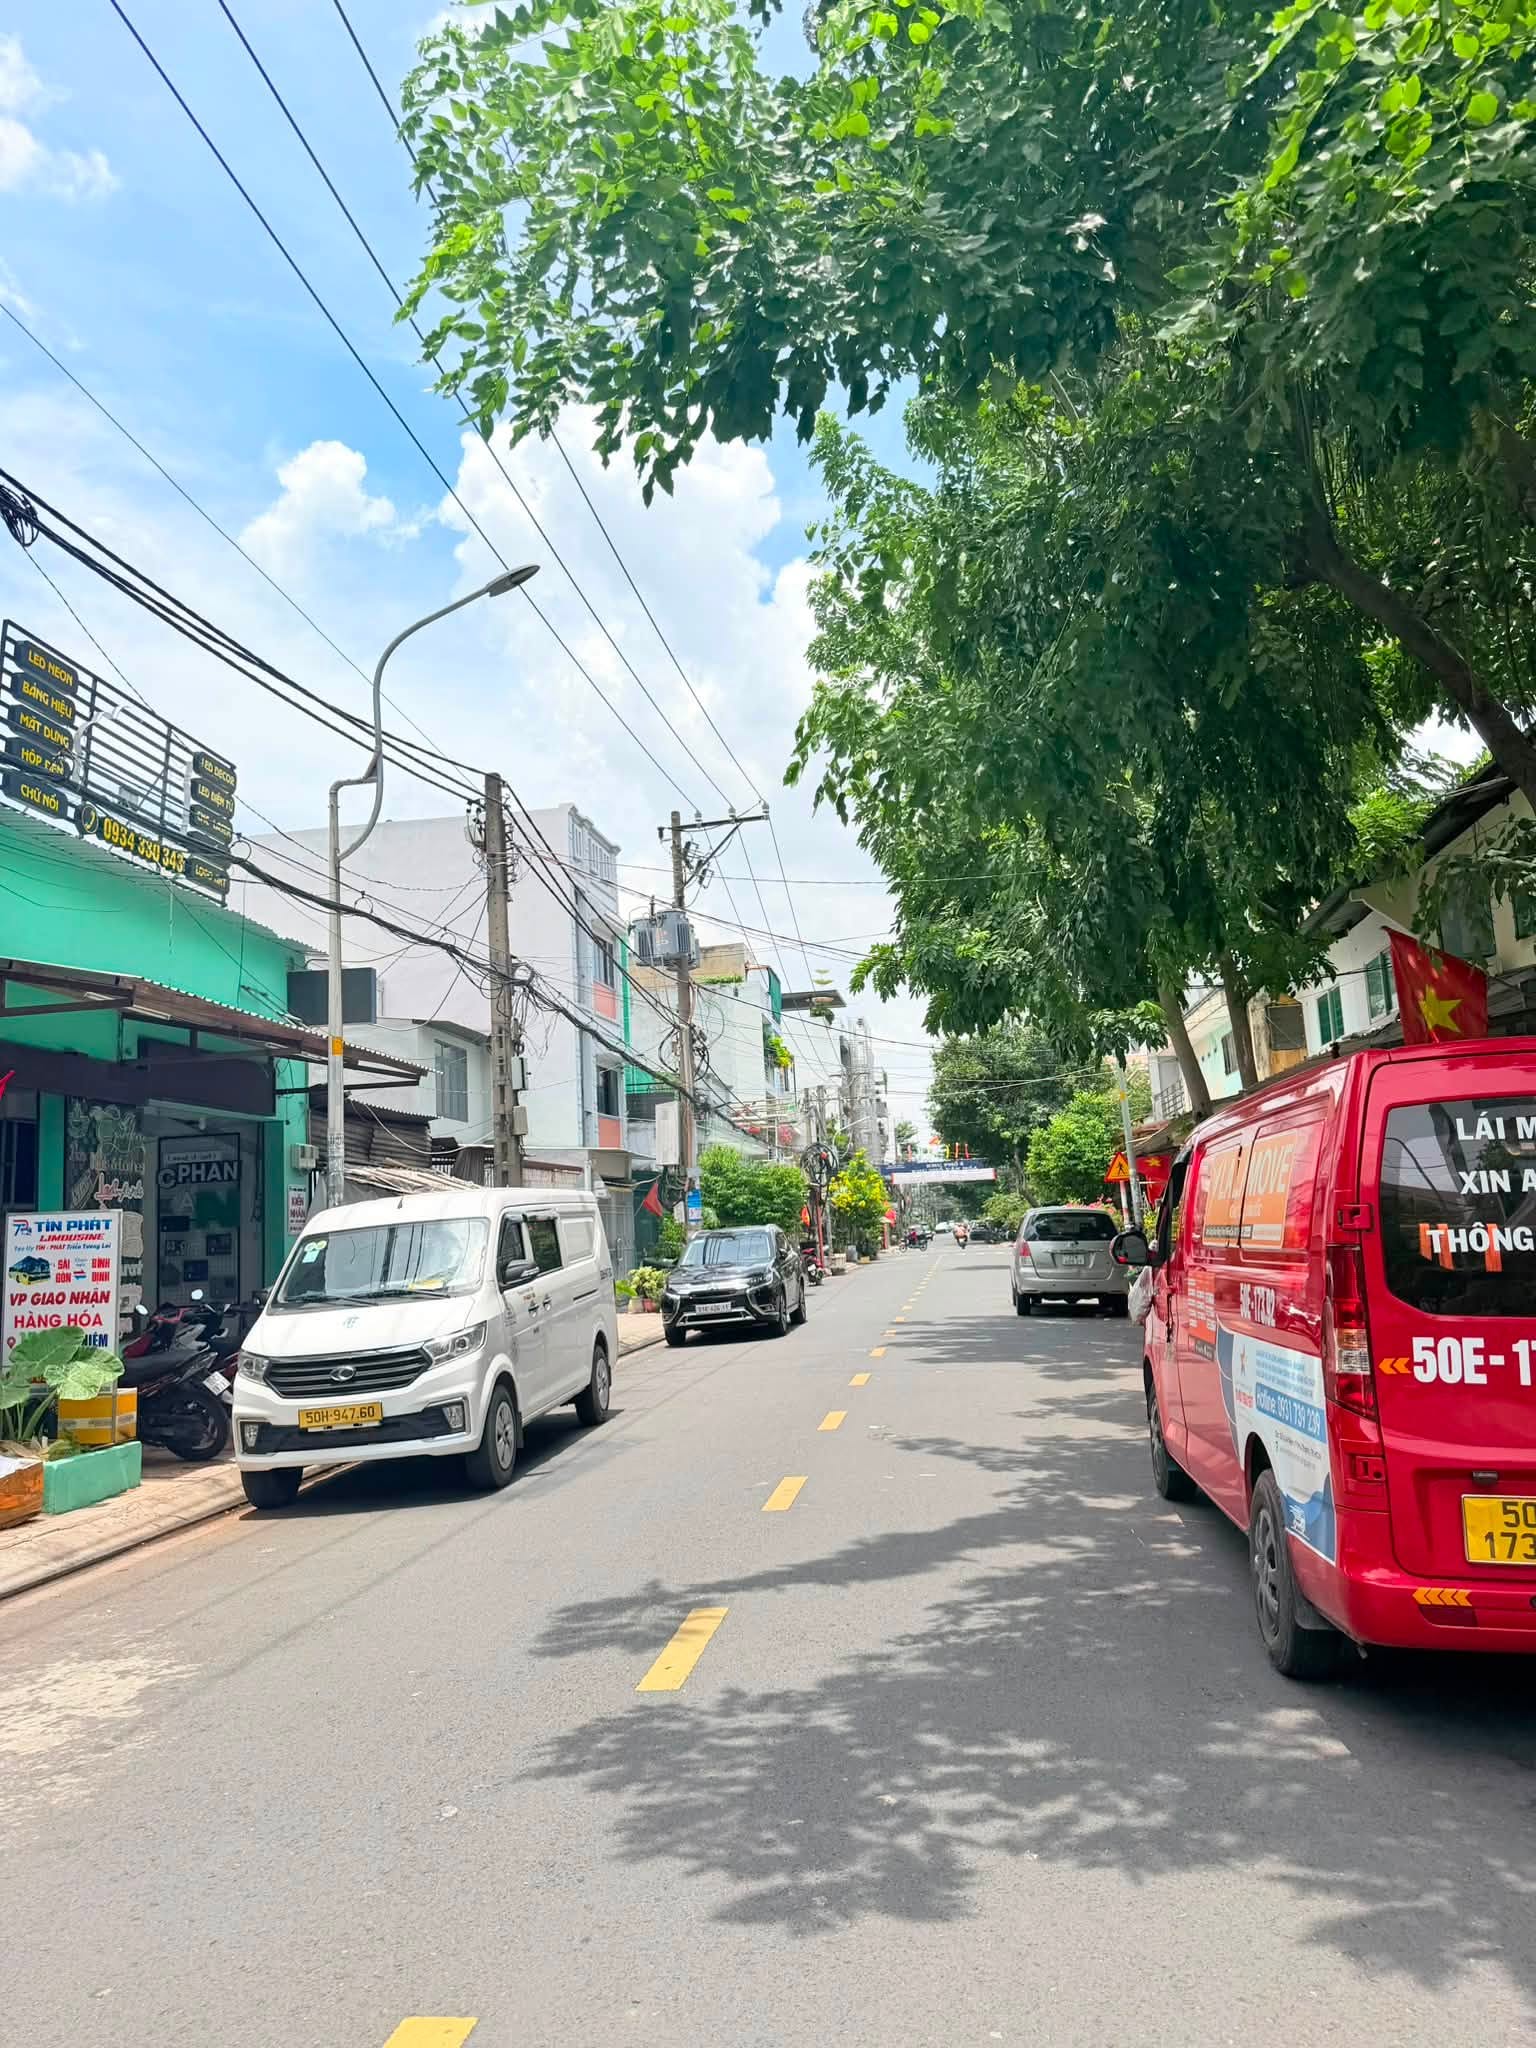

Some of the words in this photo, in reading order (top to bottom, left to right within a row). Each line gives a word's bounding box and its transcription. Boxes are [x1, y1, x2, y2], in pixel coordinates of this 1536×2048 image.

[28, 649, 46, 670] LED
[48, 661, 73, 687] NEON
[51, 697, 72, 719] HIỆU
[198, 783, 210, 799] LED
[103, 817, 135, 850] 0934
[138, 836, 160, 862] 330
[162, 848, 185, 873] 343
[1456, 1111, 1505, 1141] LÁI
[1458, 1169, 1512, 1195] XIN
[34, 1217, 62, 1232] TÍN
[66, 1216, 112, 1231] PHÁT
[40, 1233, 105, 1242] LIMOUSINE
[1426, 1221, 1535, 1253] THÔNG
[10, 1293, 27, 1306] VP
[31, 1291, 66, 1306] GIAO
[69, 1287, 111, 1308] NHẬN
[14, 1310, 62, 1329] HÀNG
[67, 1308, 103, 1327] HÓA
[1412, 1336, 1536, 1386] 50E-1
[305, 1405, 375, 1424] 50H-947.60
